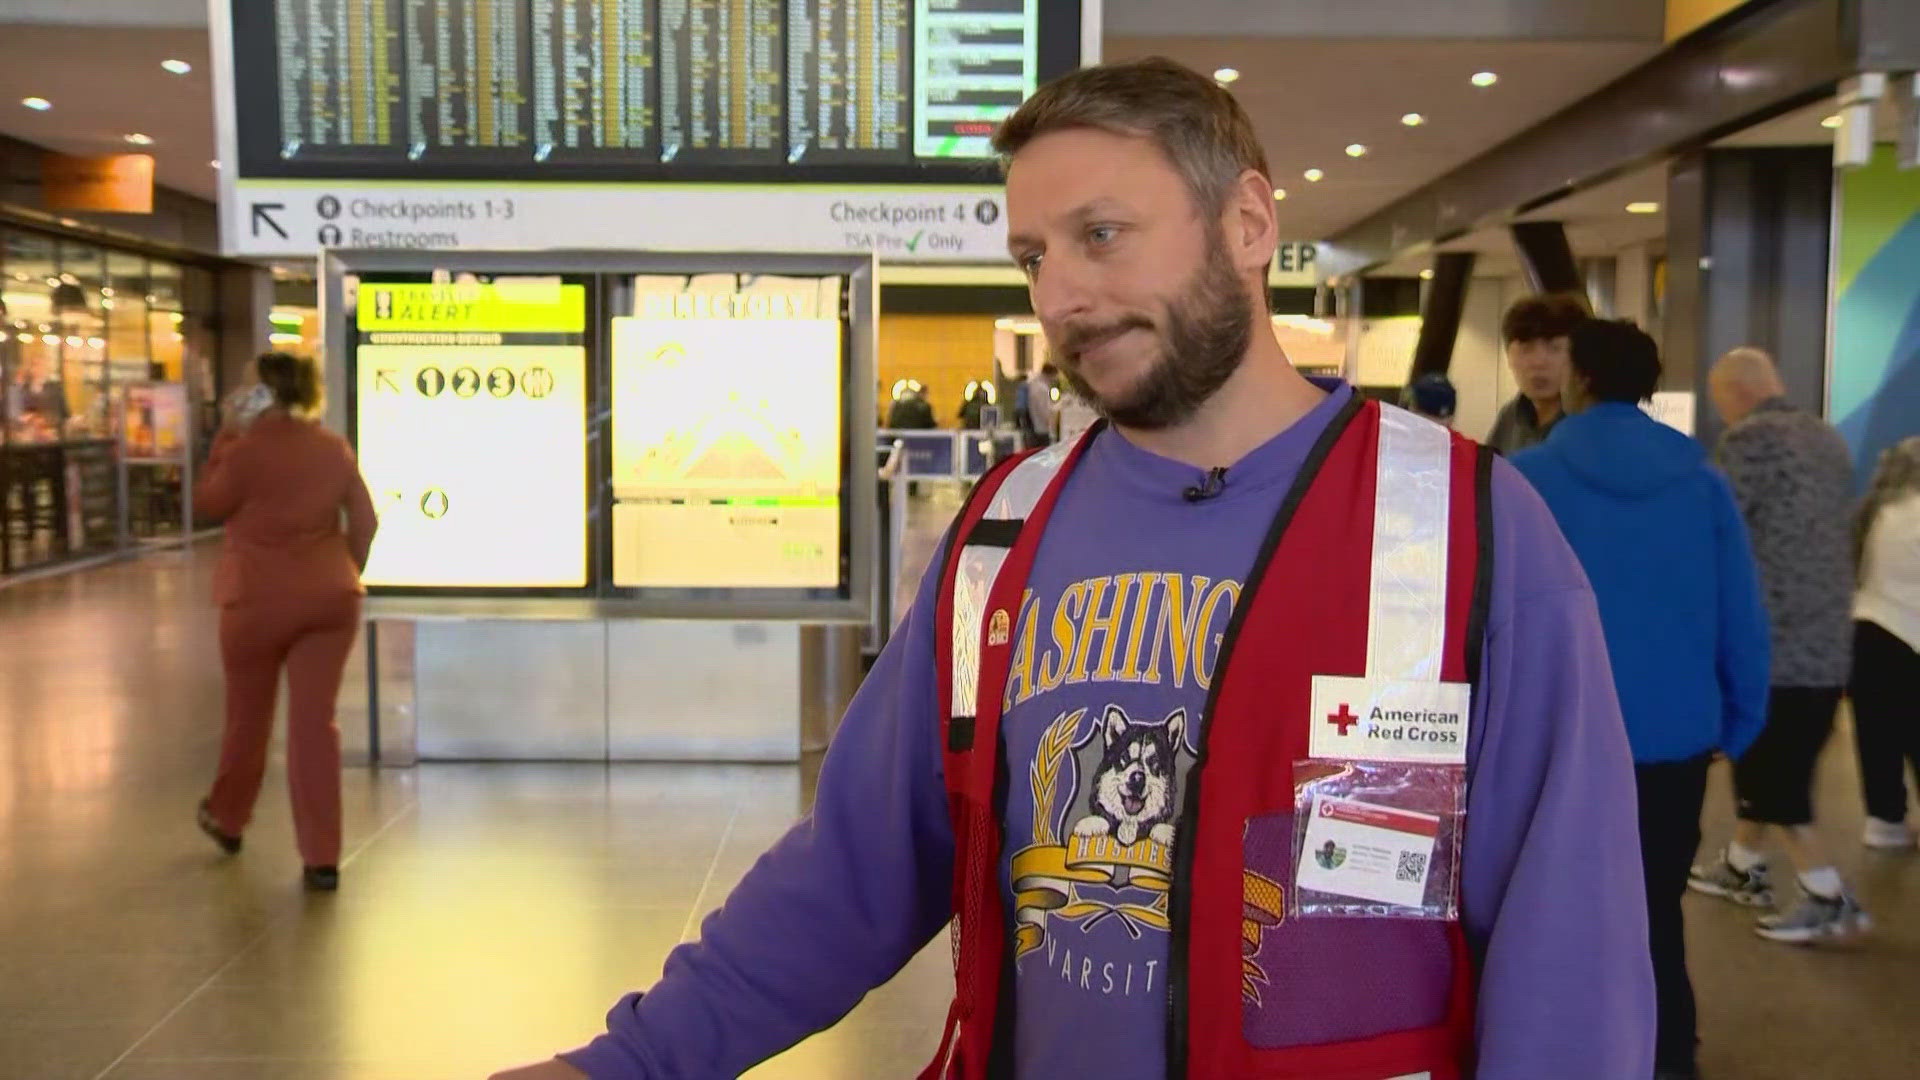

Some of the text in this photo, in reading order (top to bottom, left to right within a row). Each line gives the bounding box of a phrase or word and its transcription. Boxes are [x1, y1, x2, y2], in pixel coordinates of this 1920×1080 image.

[351, 199, 515, 222] Checkpoints 1-3
[830, 200, 966, 226] Checkpoint 4
[351, 227, 460, 248] Restrooms
[927, 232, 963, 250] Only
[398, 304, 474, 320] ALERT
[1002, 571, 1243, 715] ASHING
[1370, 706, 1459, 724] American
[1368, 724, 1457, 743] Red Cross
